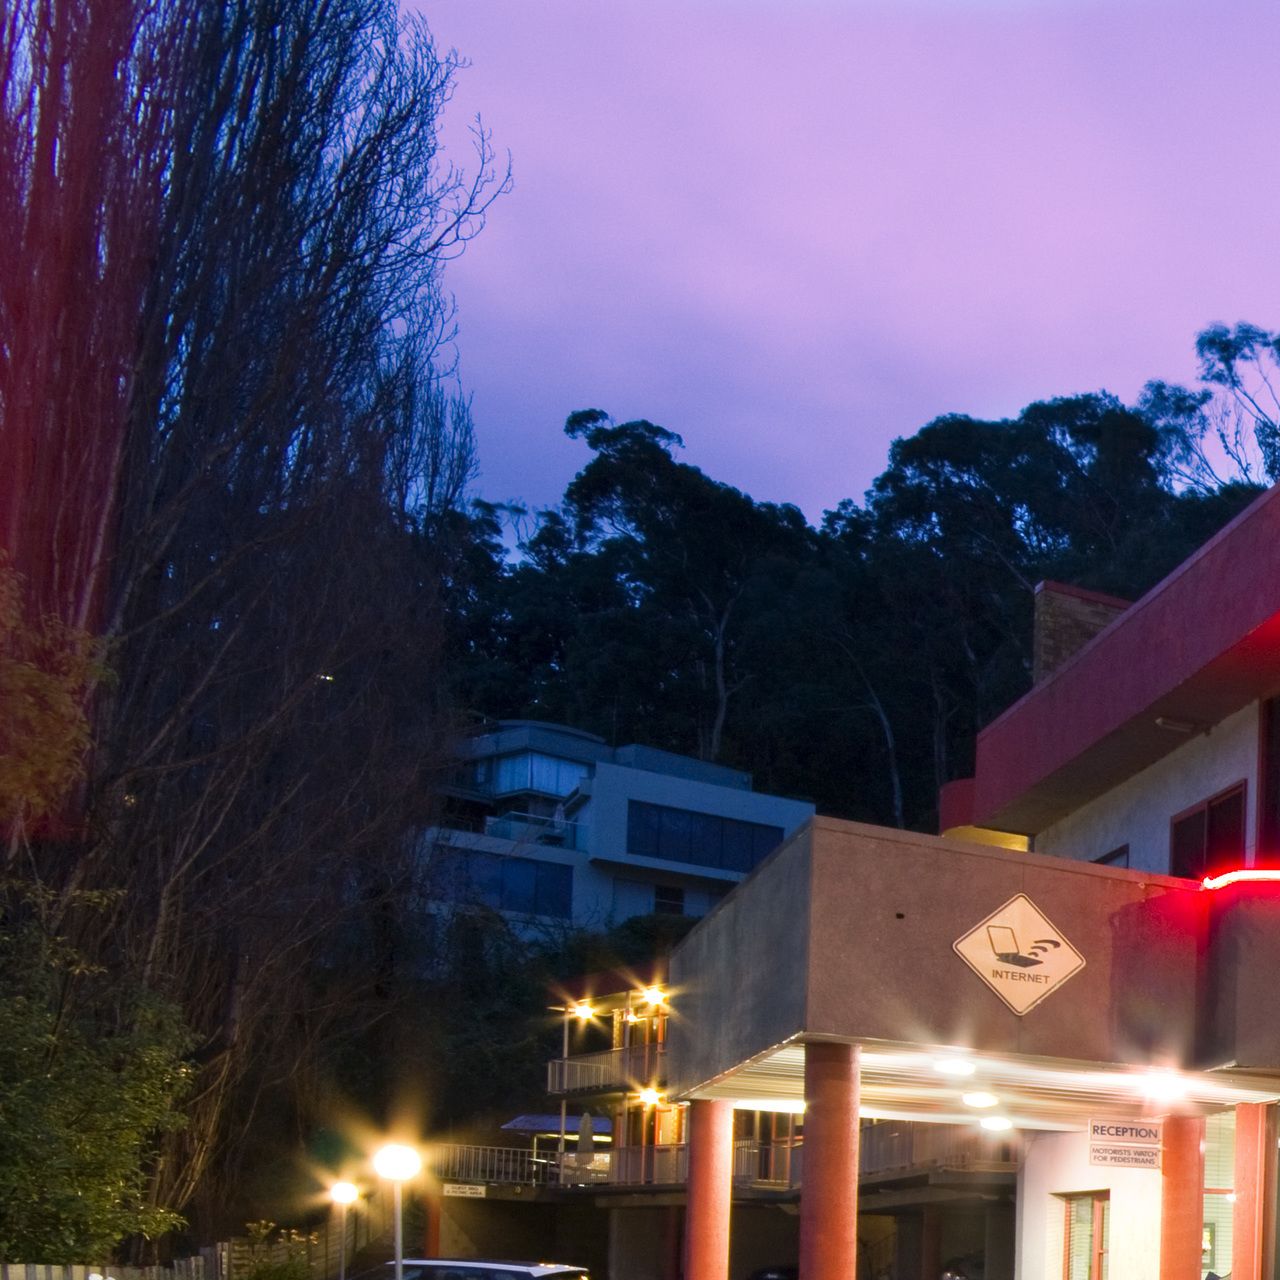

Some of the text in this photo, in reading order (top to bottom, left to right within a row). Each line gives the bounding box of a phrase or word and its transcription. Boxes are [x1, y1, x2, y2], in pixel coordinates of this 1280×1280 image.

[992, 969, 1050, 984] INTERNET
[1092, 1125, 1158, 1139] RECEPTION
[1092, 1147, 1158, 1158] MOTORISTS WATCH
[1093, 1154, 1155, 1165] FOR PEDESTRIANS
